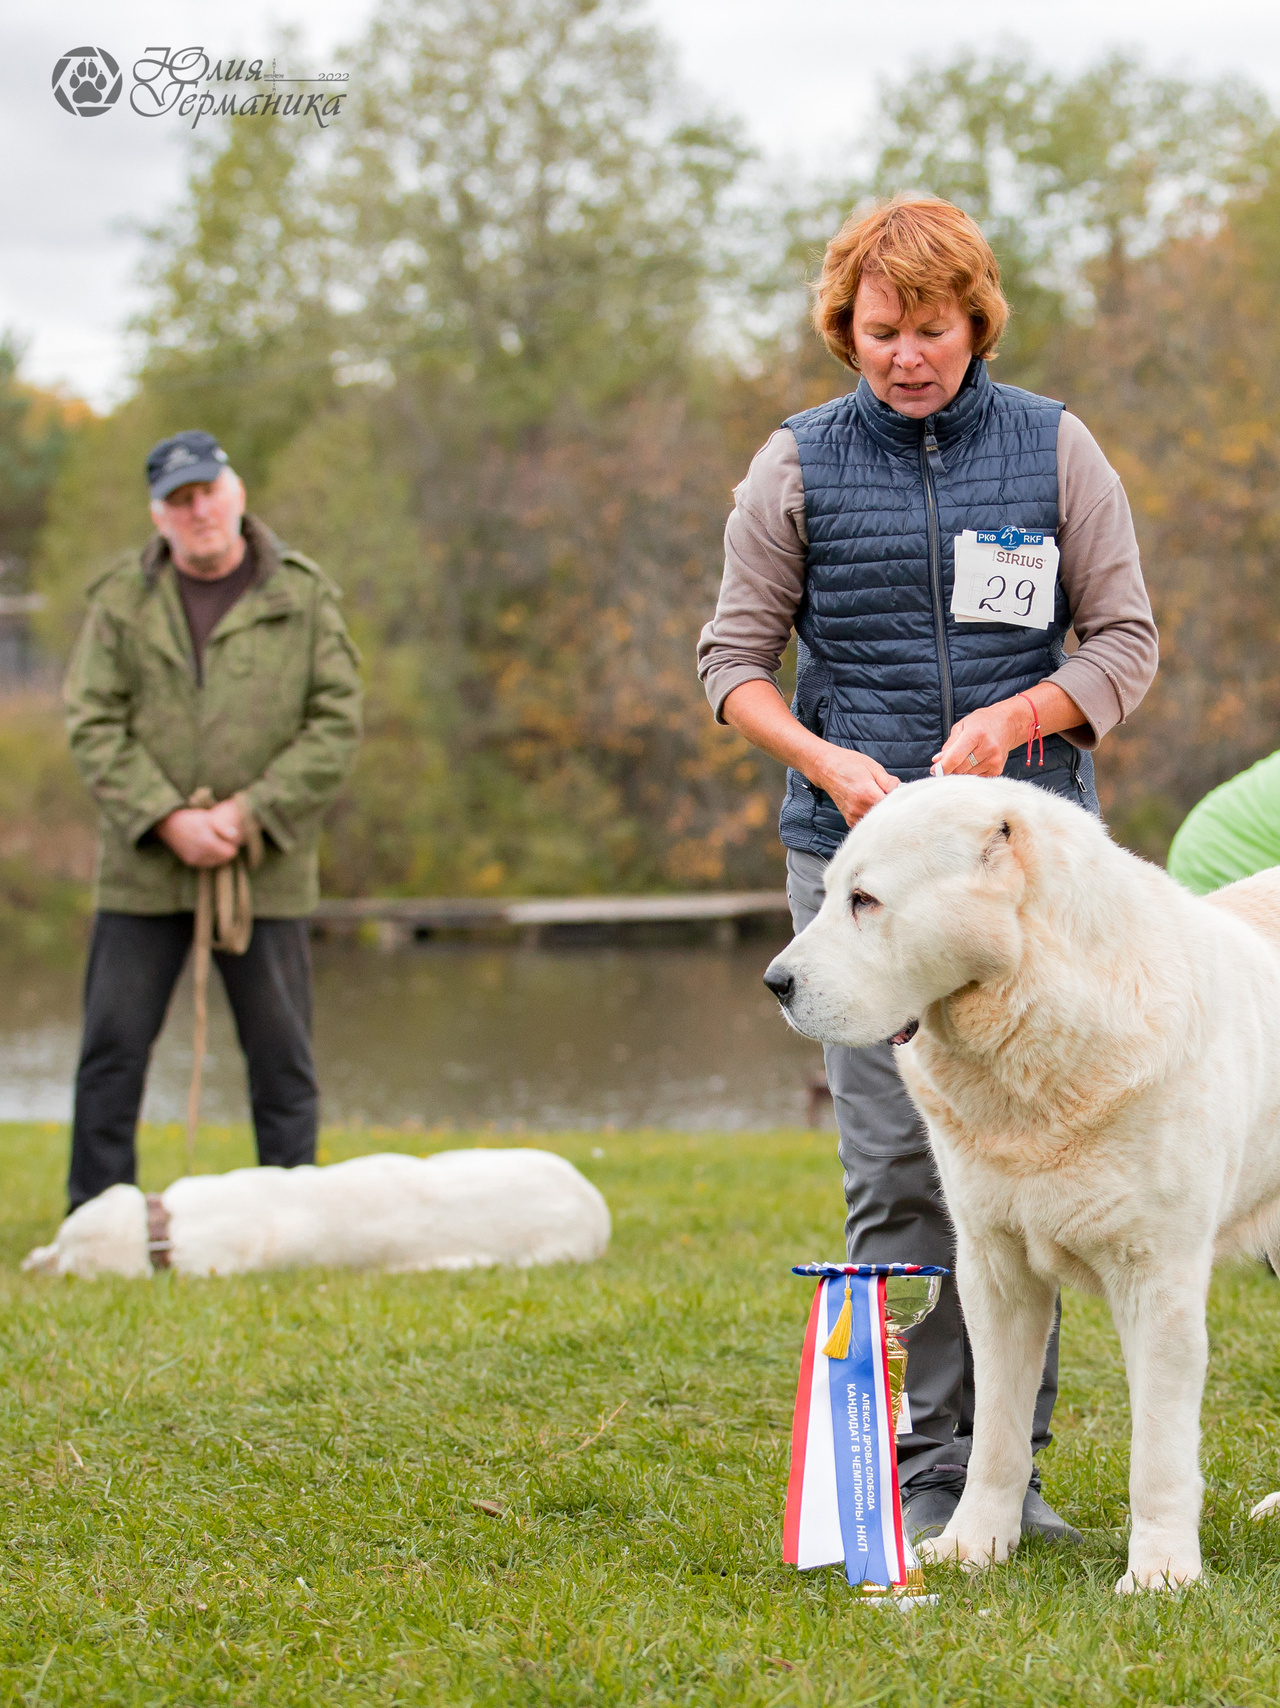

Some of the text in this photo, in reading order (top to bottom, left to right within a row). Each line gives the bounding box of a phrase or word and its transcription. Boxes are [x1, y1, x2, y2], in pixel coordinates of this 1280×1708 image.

[978, 533, 997, 542] РКФ
[1023, 535, 1042, 544] RKF
[996, 551, 1044, 570] SIRIUS
[978, 575, 1036, 617] 29
[846, 1383, 869, 1552] КАНДИДАТ В ЧЕМПИОНЫ НКП
[865, 1465, 876, 1511] СЛОБОДА
